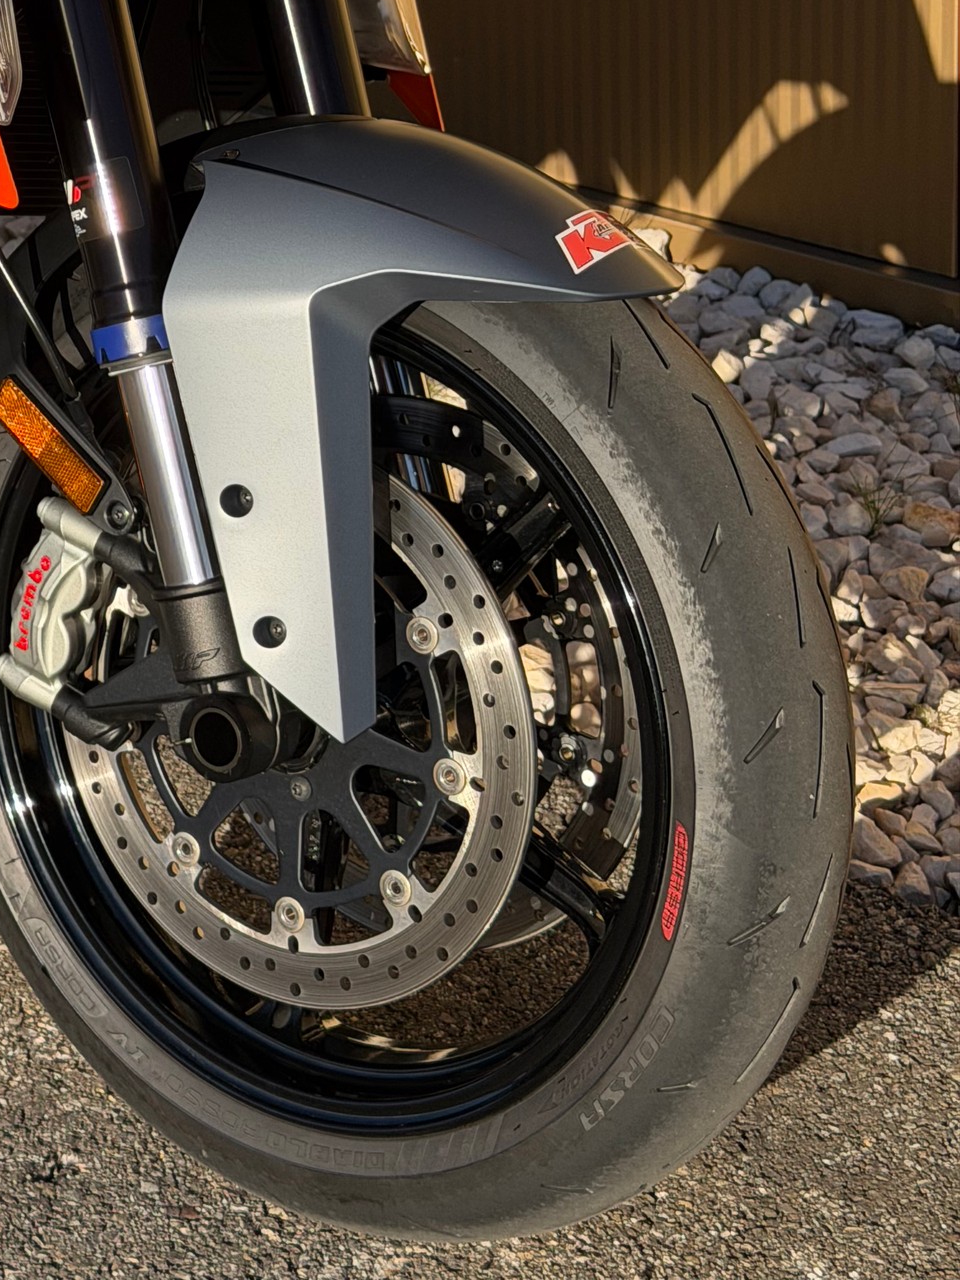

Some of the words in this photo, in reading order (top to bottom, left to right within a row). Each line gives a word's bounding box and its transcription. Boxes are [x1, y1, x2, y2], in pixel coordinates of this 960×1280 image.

[14, 555, 51, 652] brembo
[35, 927, 96, 1011] CORSA
[579, 1005, 676, 1131] CORSA
[265, 1131, 385, 1171] DIABLO
